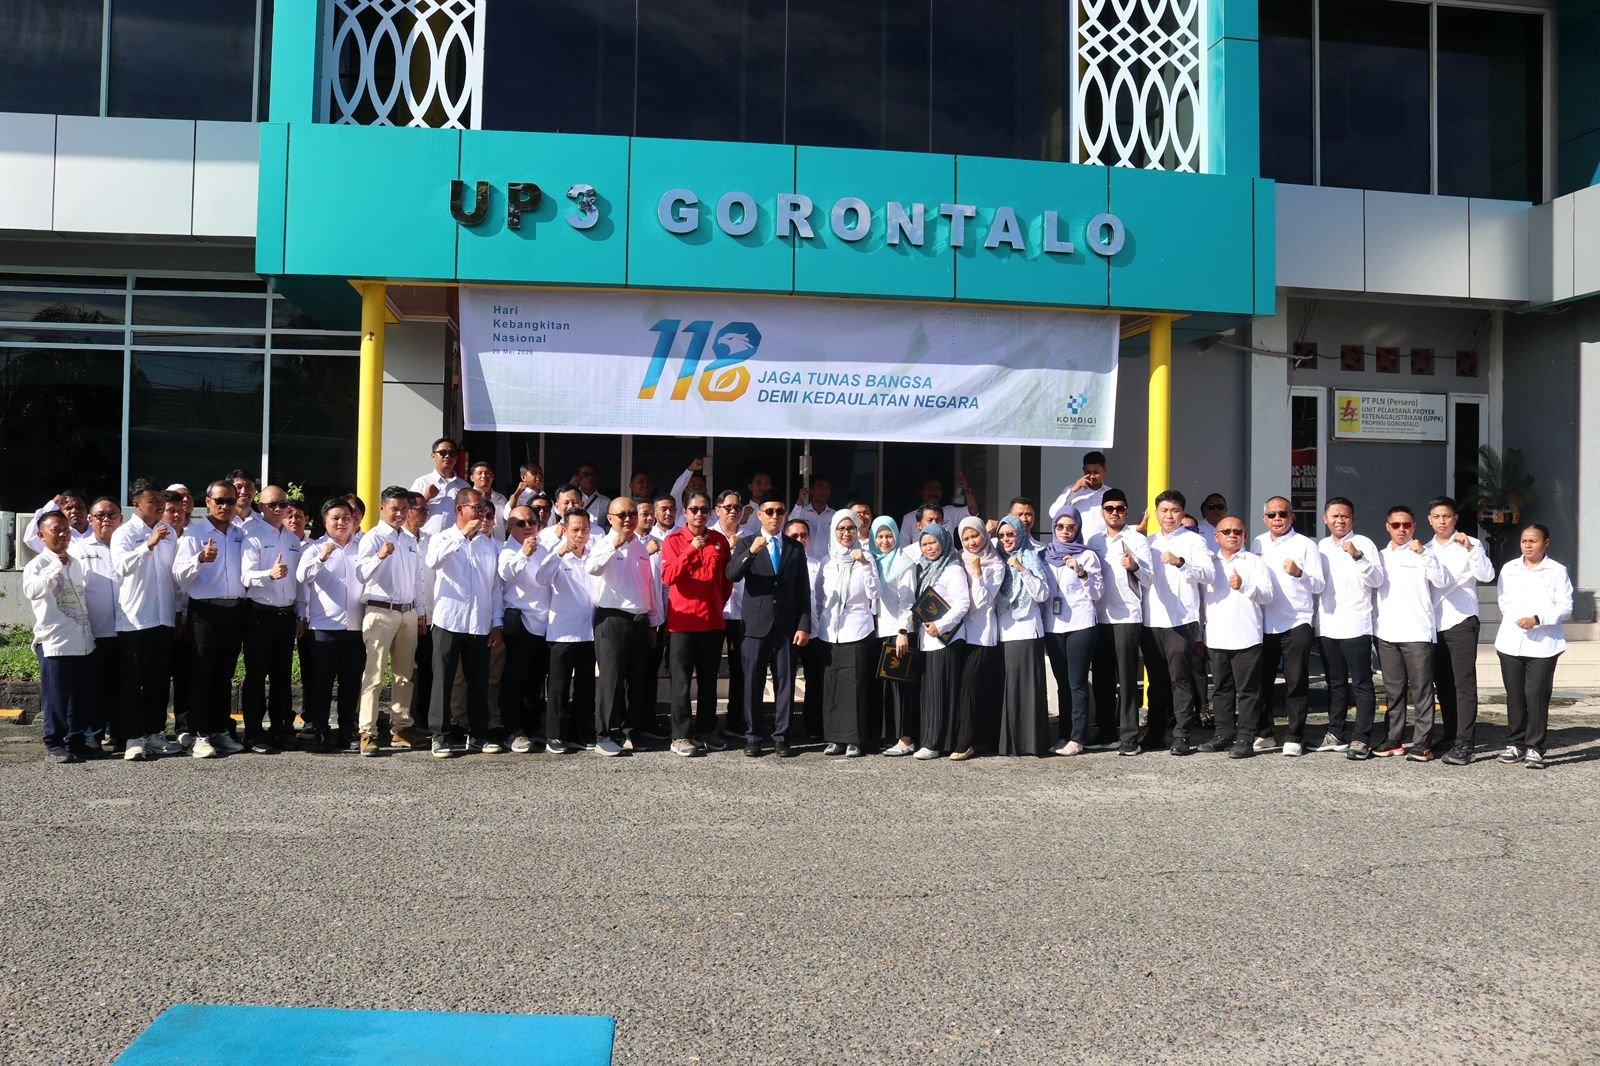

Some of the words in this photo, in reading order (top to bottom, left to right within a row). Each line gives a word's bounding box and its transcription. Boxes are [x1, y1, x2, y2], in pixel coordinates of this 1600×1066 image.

[450, 180, 541, 229] UP
[564, 183, 599, 229] 3
[657, 188, 1125, 256] GORONTALO
[493, 305, 518, 315] Hari
[493, 319, 570, 331] Kebangkitan
[493, 333, 546, 343] Nasional
[637, 318, 762, 402] 118
[758, 371, 801, 385] JAGA
[807, 372, 861, 387] TUNAS
[865, 374, 933, 389] BANGSA
[757, 389, 798, 404] DEMI
[802, 391, 910, 407] KEDAULATAN
[913, 395, 979, 409] NEGARA
[1371, 397, 1386, 405] PLN
[1387, 398, 1418, 407] (Persero)
[1056, 416, 1097, 424] KOMDIGI
[1361, 413, 1422, 421] KETENAGALISTRIKAN
[1423, 415, 1444, 423] (UPPK)
